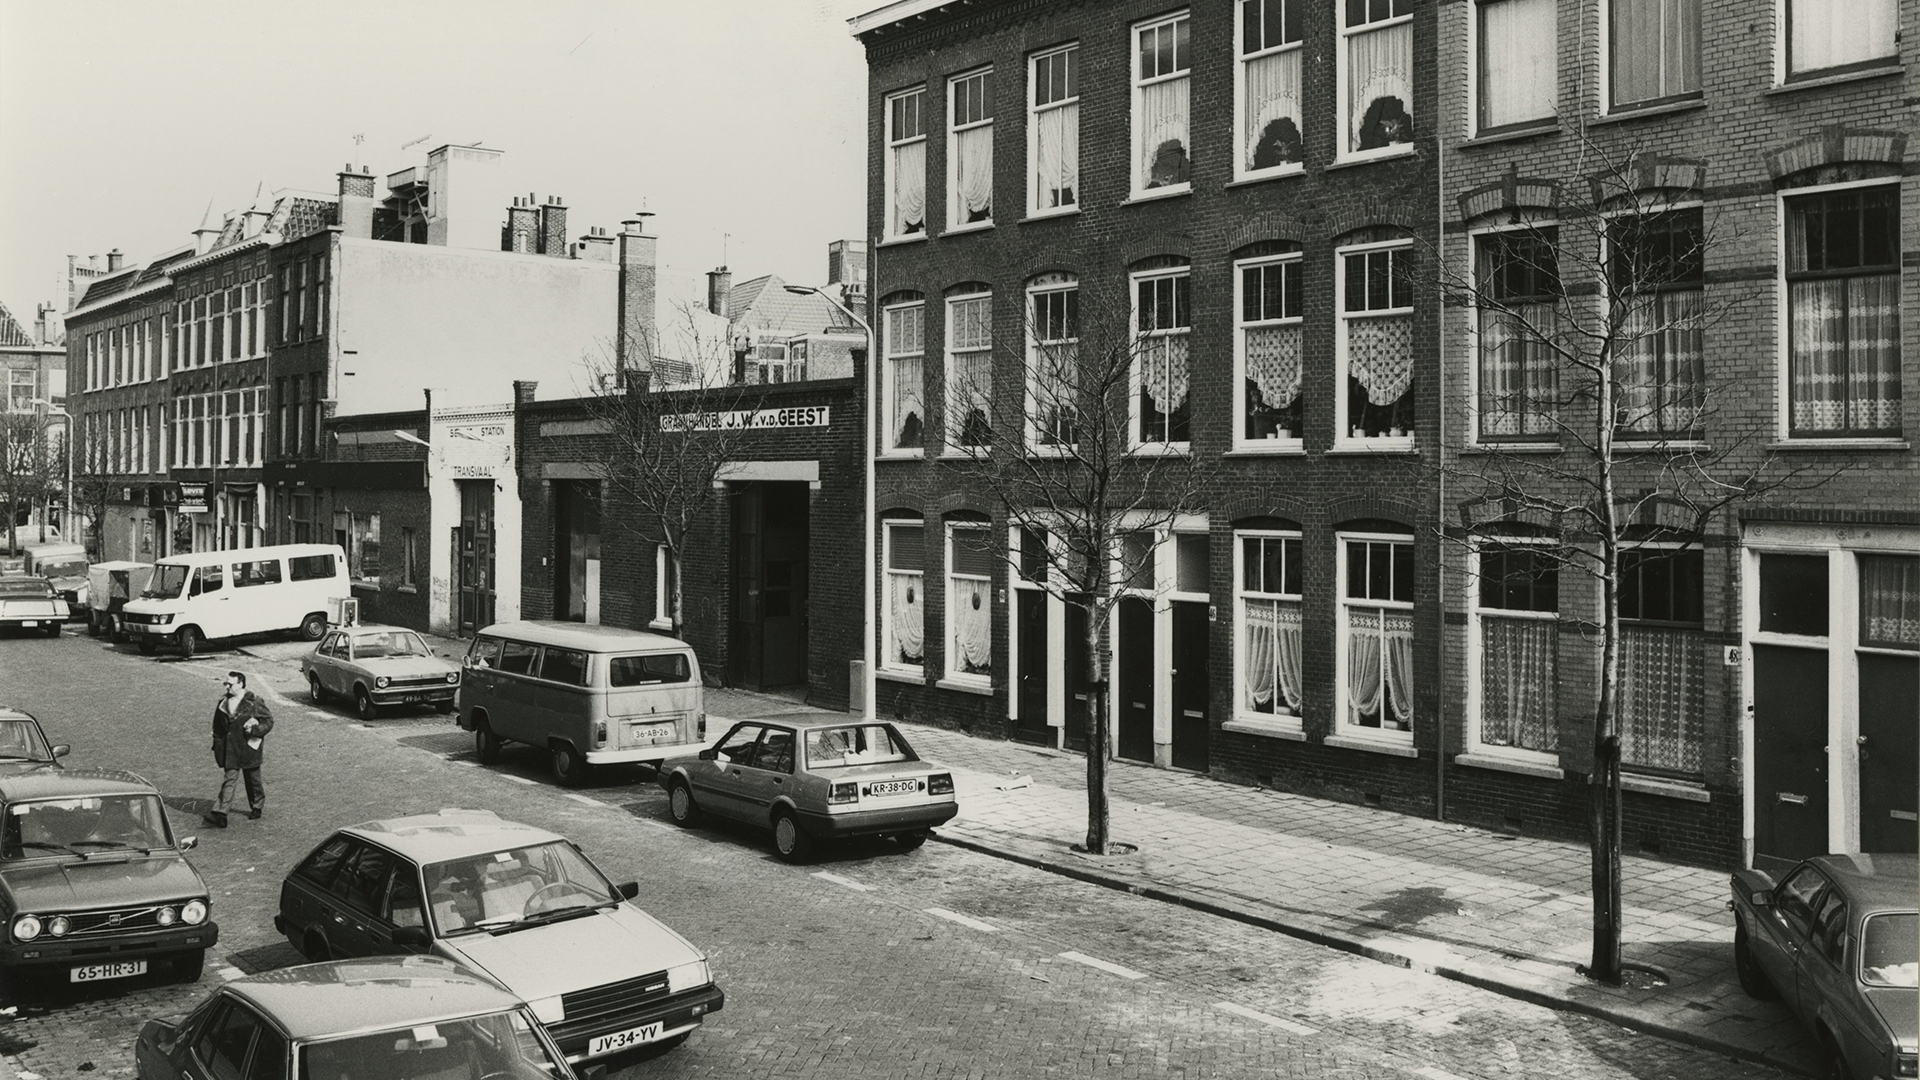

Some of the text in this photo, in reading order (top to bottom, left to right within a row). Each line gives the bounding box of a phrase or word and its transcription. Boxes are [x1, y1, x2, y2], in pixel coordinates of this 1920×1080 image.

[481, 426, 505, 437] STATION
[1729, 648, 1739, 663] 48
[635, 728, 669, 739] 36-AB-26
[873, 781, 914, 794] KR-38-DG
[77, 961, 141, 980] 65-HR-31
[595, 1024, 658, 1053] JV-34-YV
